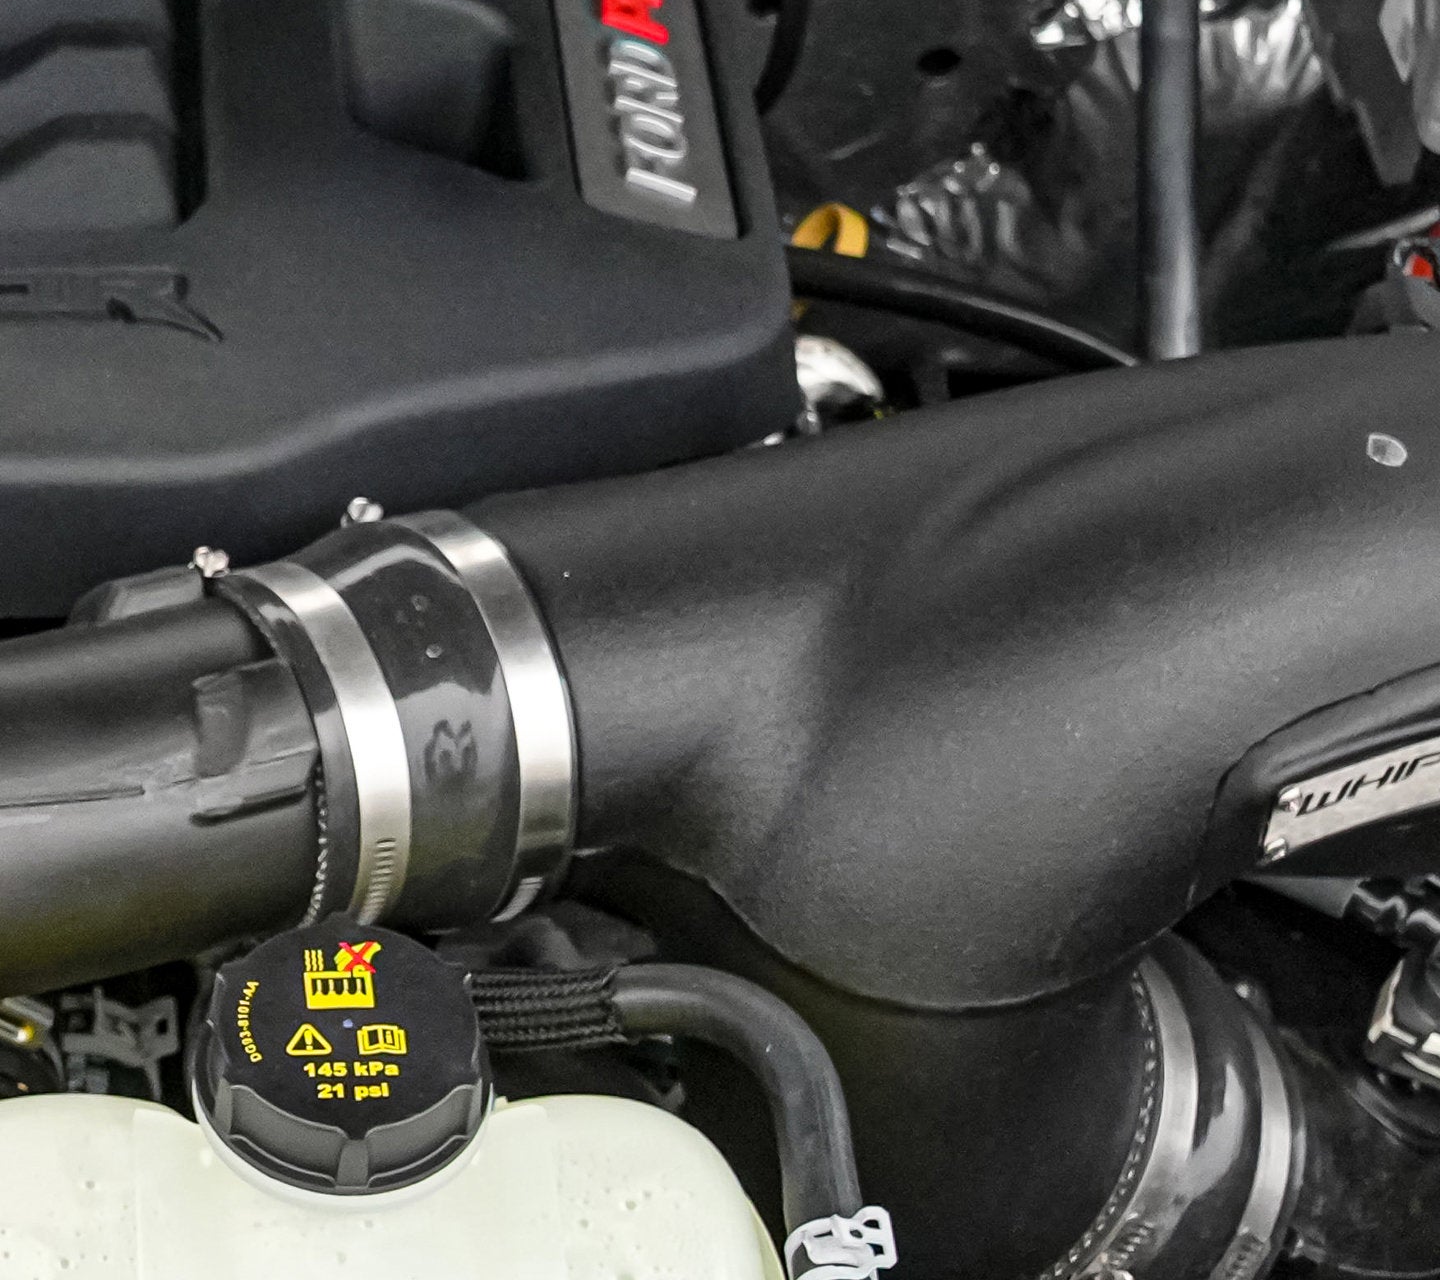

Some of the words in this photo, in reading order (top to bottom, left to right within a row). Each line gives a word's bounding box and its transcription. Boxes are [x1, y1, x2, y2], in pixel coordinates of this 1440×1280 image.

[607, 40, 698, 205] FORD
[304, 1061, 347, 1077] 145
[354, 1061, 399, 1077] kPa
[317, 1083, 344, 1098] 21
[354, 1082, 389, 1101] psi
